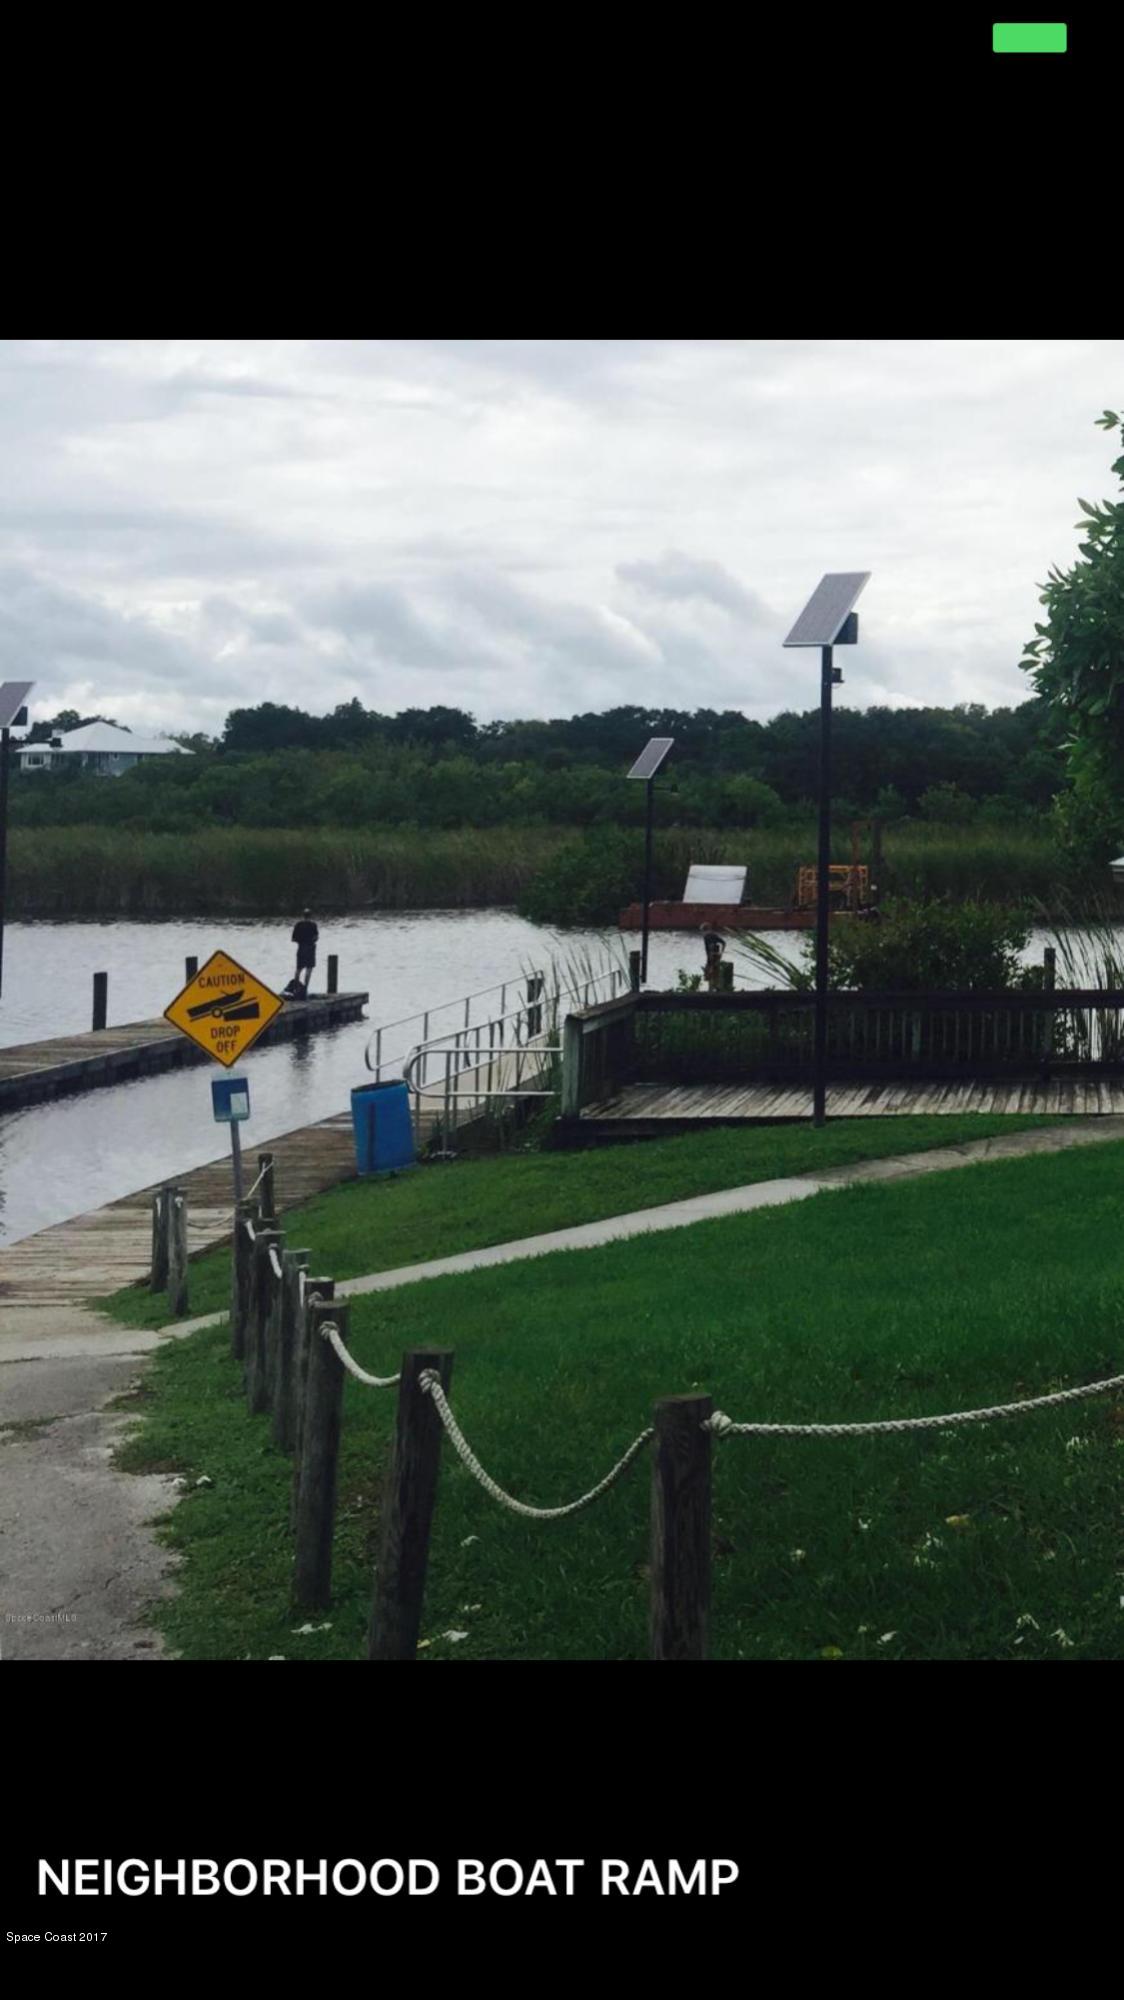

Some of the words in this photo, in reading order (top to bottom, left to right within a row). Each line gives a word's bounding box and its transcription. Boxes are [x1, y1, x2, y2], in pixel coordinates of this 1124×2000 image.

[198, 974, 246, 989] CAUTION
[210, 1025, 240, 1039] DROP
[216, 1040, 237, 1053] OFF
